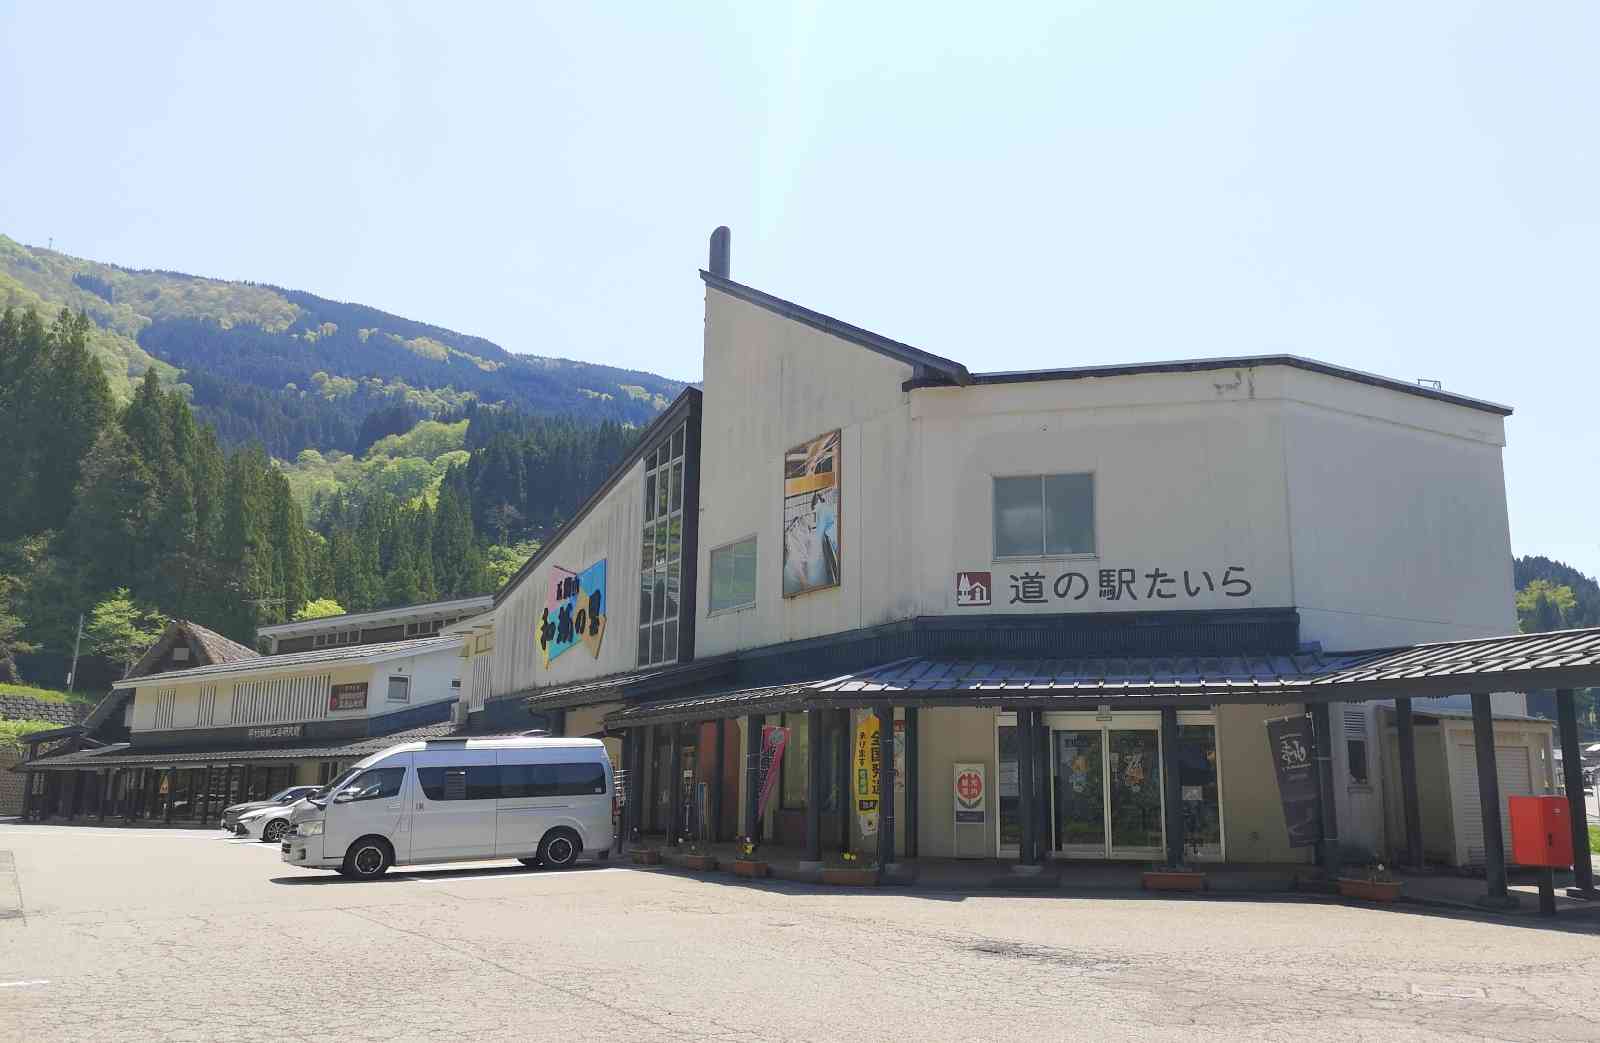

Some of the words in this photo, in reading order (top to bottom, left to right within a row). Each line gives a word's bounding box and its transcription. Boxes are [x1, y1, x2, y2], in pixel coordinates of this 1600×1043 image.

[1009, 566, 1252, 605] 道の駅たいら
